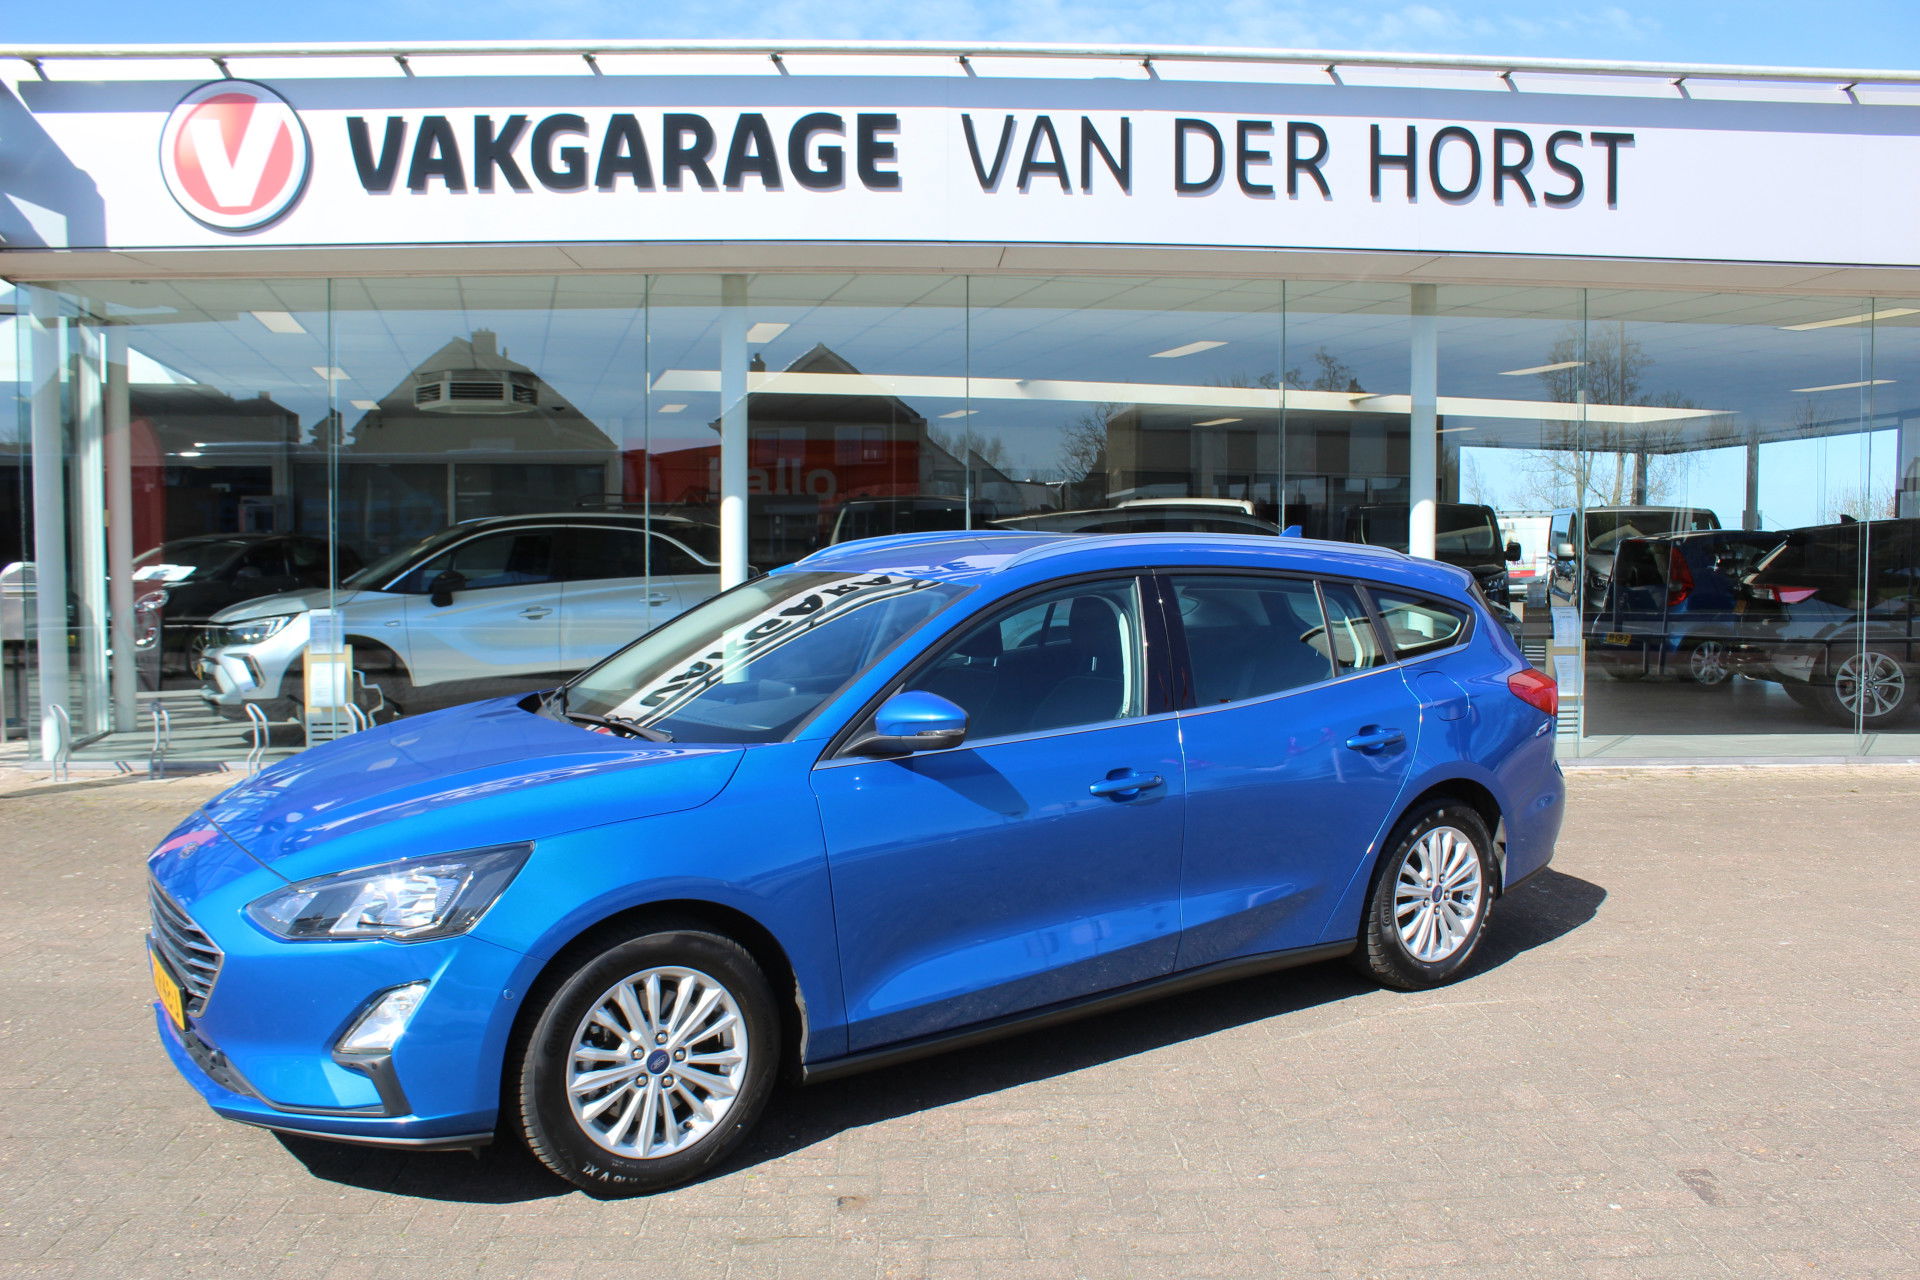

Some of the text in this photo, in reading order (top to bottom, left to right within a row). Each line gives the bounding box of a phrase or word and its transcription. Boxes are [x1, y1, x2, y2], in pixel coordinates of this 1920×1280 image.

[346, 113, 1636, 207] VAKGARAGE VAN DER HORST
